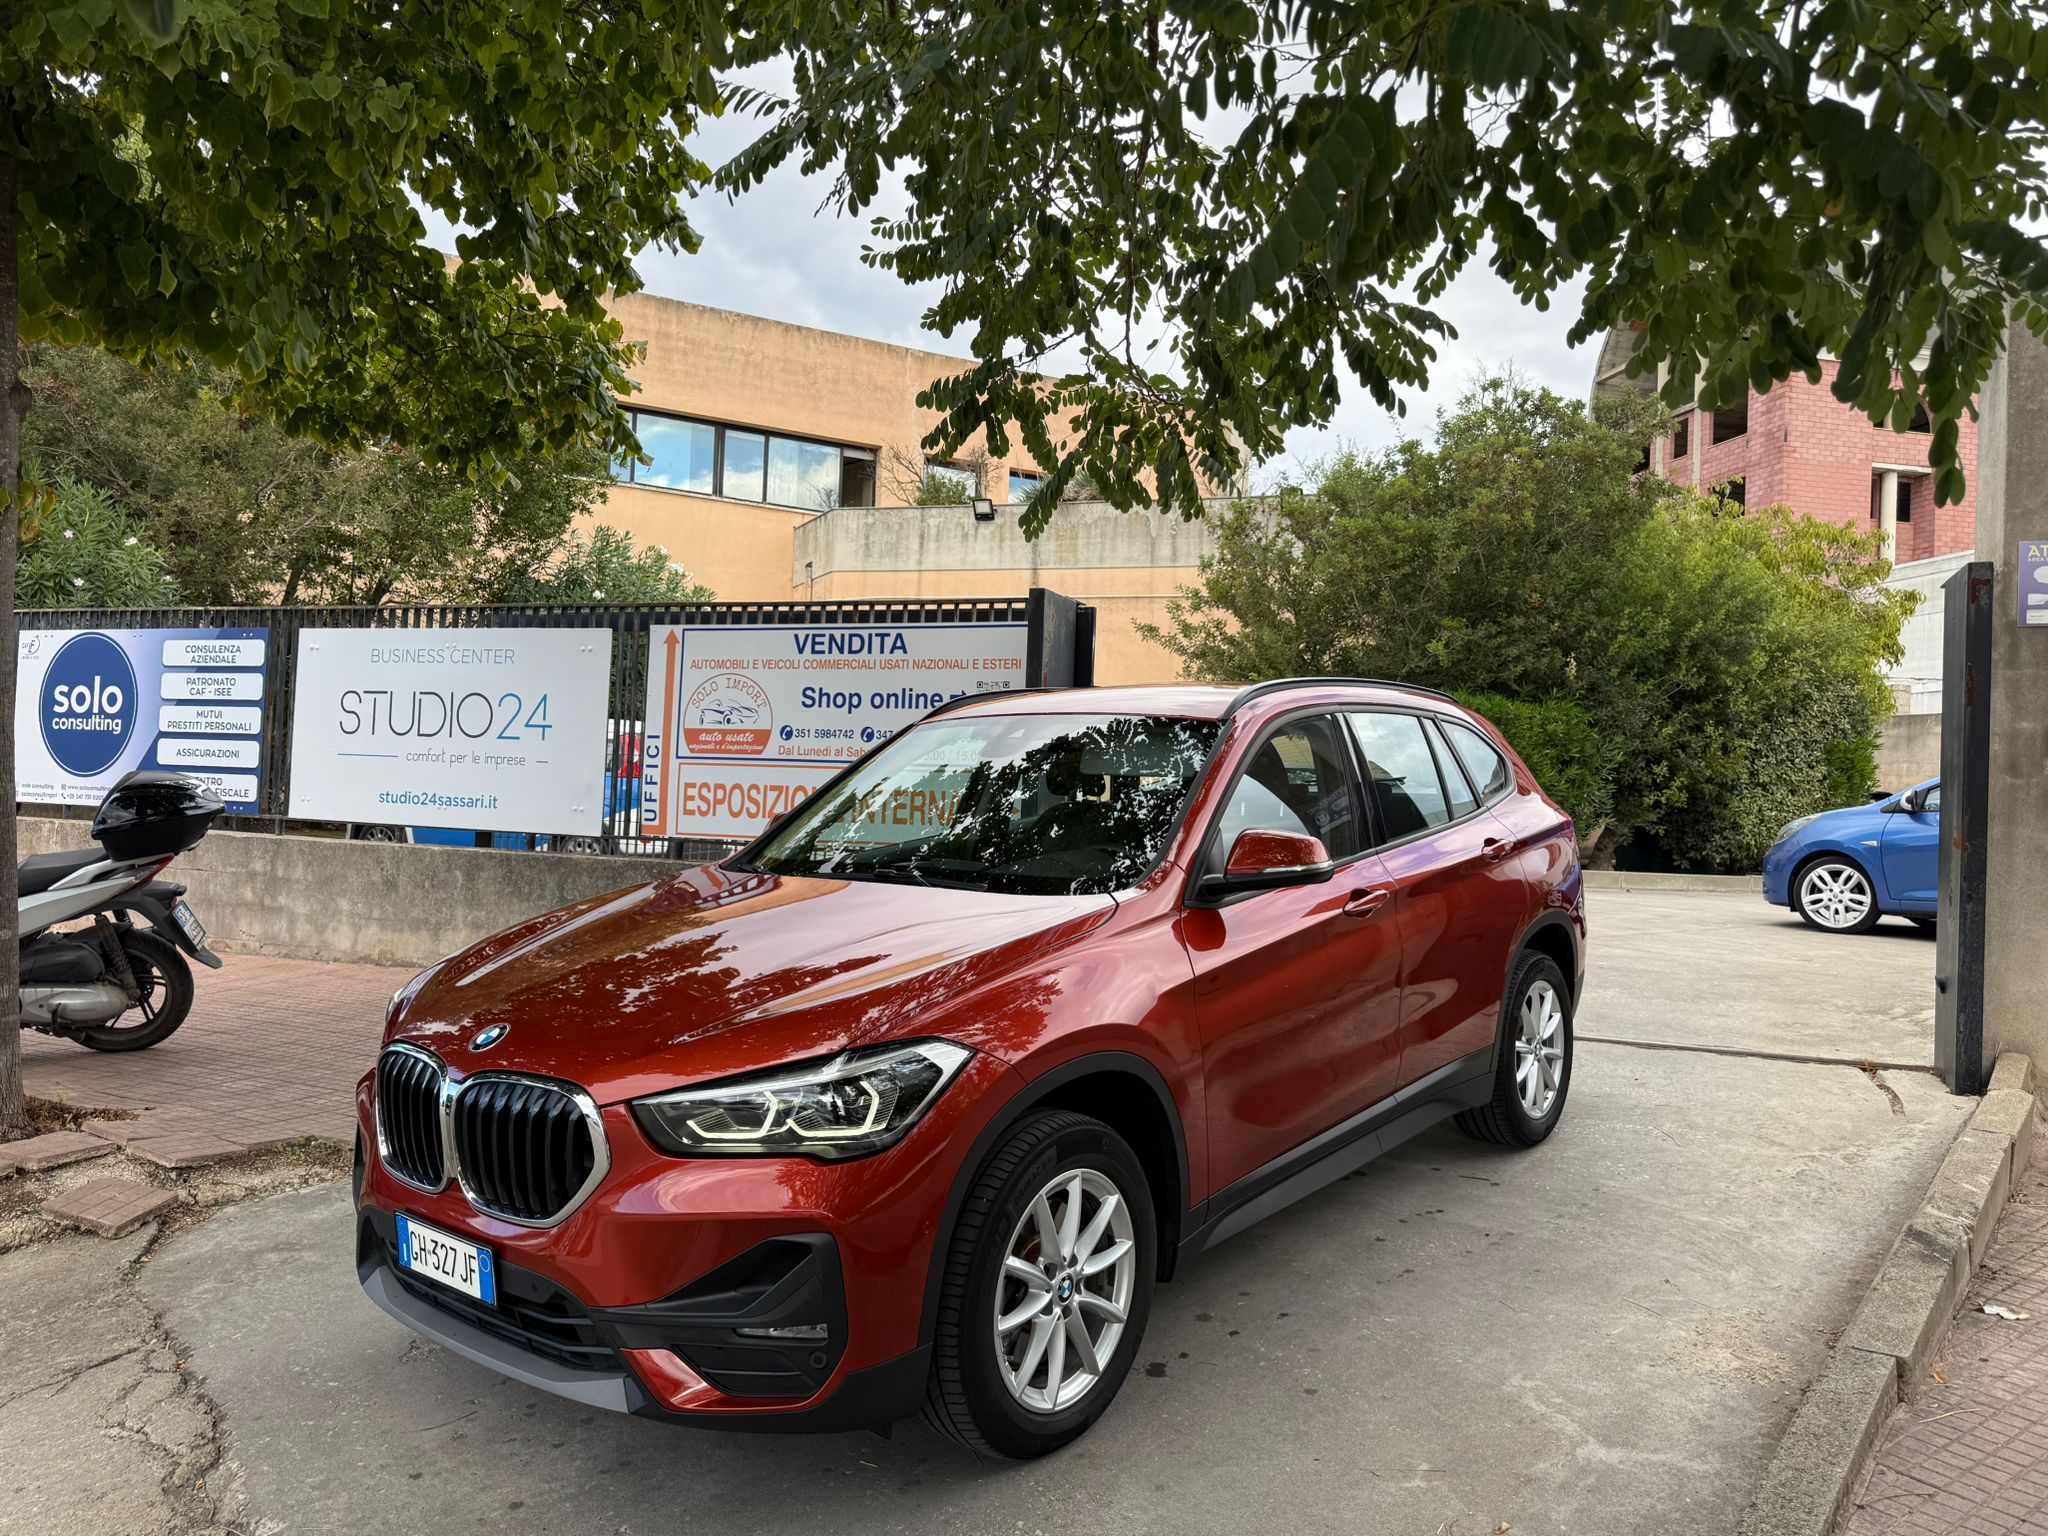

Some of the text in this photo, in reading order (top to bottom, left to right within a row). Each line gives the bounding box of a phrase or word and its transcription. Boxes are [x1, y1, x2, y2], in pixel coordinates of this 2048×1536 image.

[185, 645, 241, 653] CONSULENZA
[794, 633, 908, 655] VENDITA
[190, 655, 237, 664] AZIENDALE
[371, 648, 515, 664] BUSINESS CENTER
[690, 659, 1022, 670] AUTOMOBILI E VEICOLI COMMERCIALI USATI NAZIONALI E ESTERI
[186, 678, 236, 686] PATRONATO
[53, 676, 123, 713] solo
[189, 688, 207, 696] CAF
[213, 688, 232, 696] ISEE
[691, 677, 767, 710] SOLO IMPORT
[801, 687, 944, 714] Shop online
[196, 710, 222, 719] MUTUI
[338, 690, 553, 741] STUDIO24
[52, 714, 122, 735] consulting
[167, 721, 252, 731] PRESTITI PERSONALI
[699, 732, 754, 742] auto usate
[794, 729, 893, 740] 351 5984742 347
[176, 749, 240, 758] ASSICURAZIONI
[778, 745, 794, 755] Dal
[834, 746, 844, 757] al
[846, 746, 867, 758] Sab
[406, 748, 527, 770] comfort per le imprese
[194, 777, 223, 786] NTRO
[644, 735, 660, 822] UFFICI
[215, 788, 249, 797] FISCALE
[378, 791, 498, 809] studio24sassari.it
[683, 783, 832, 820] ESPOSIZIO
